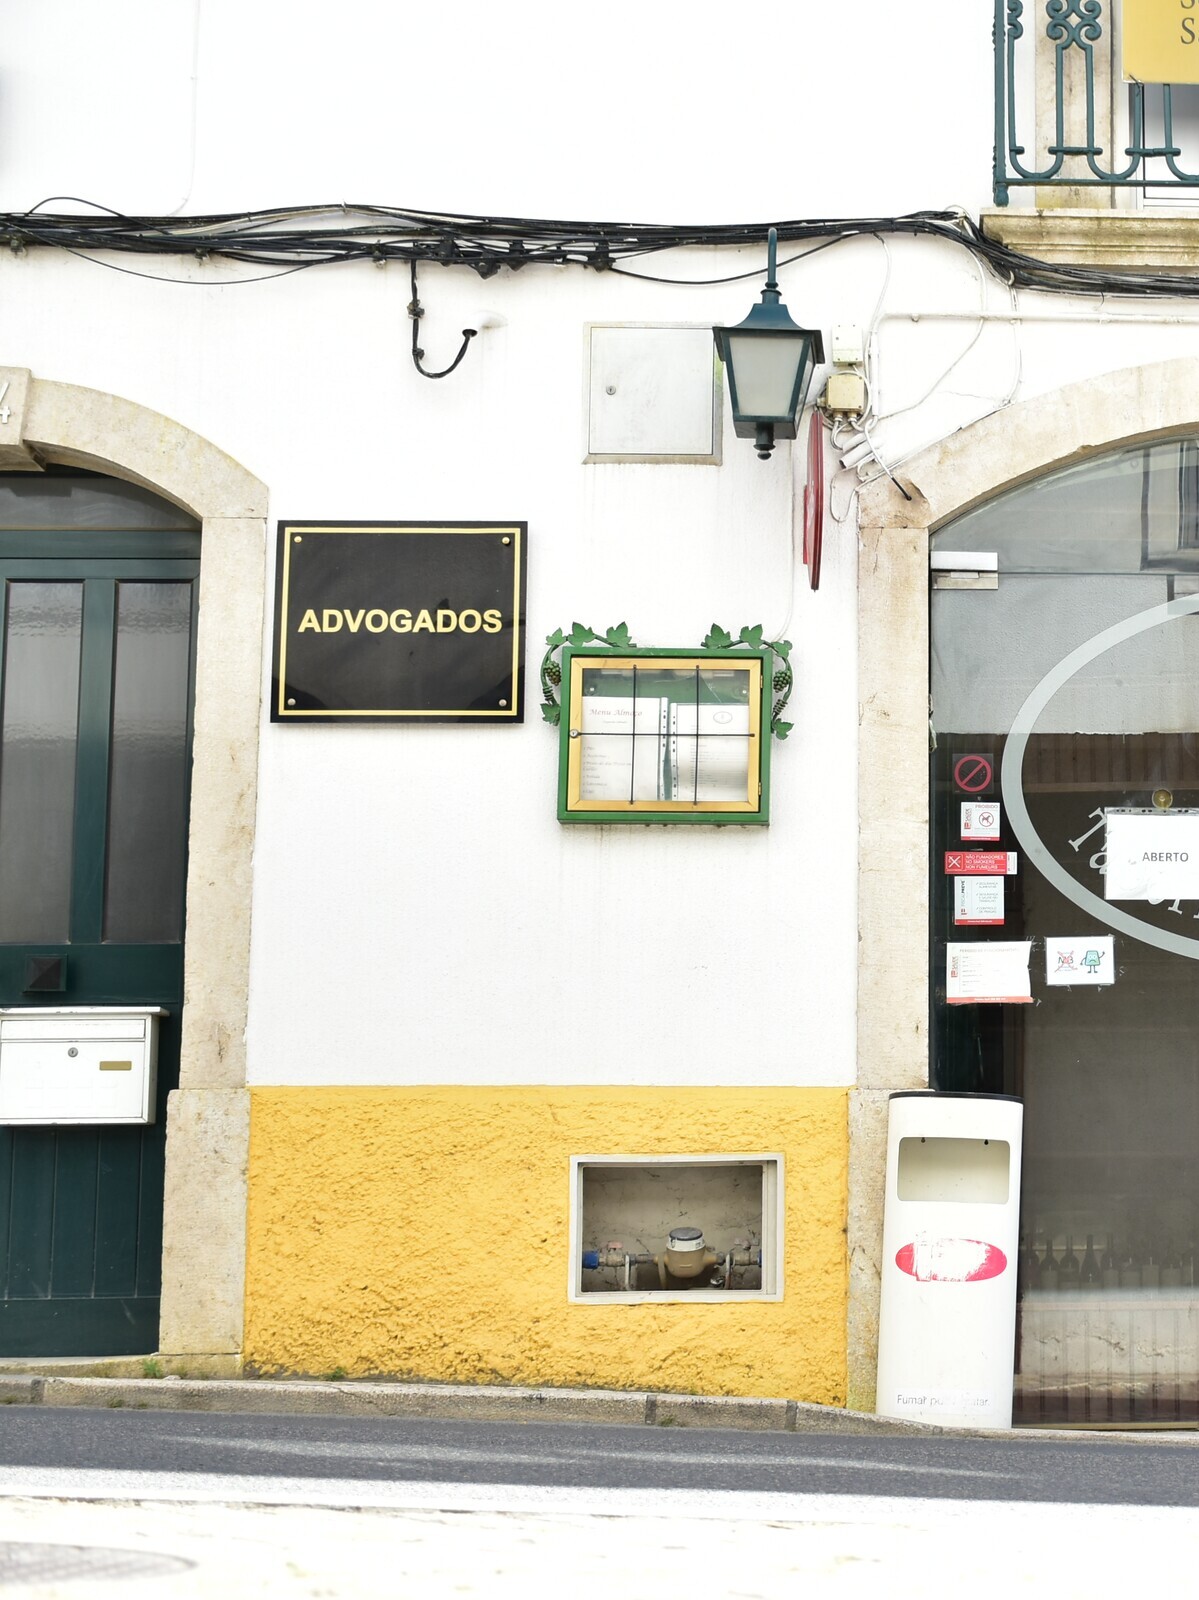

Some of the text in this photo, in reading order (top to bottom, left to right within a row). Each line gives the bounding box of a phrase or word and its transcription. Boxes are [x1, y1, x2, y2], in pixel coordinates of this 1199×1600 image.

[297, 609, 503, 633] ADVOGADOS
[1142, 852, 1189, 862] ABERTO
[897, 1394, 927, 1405] Fumar
